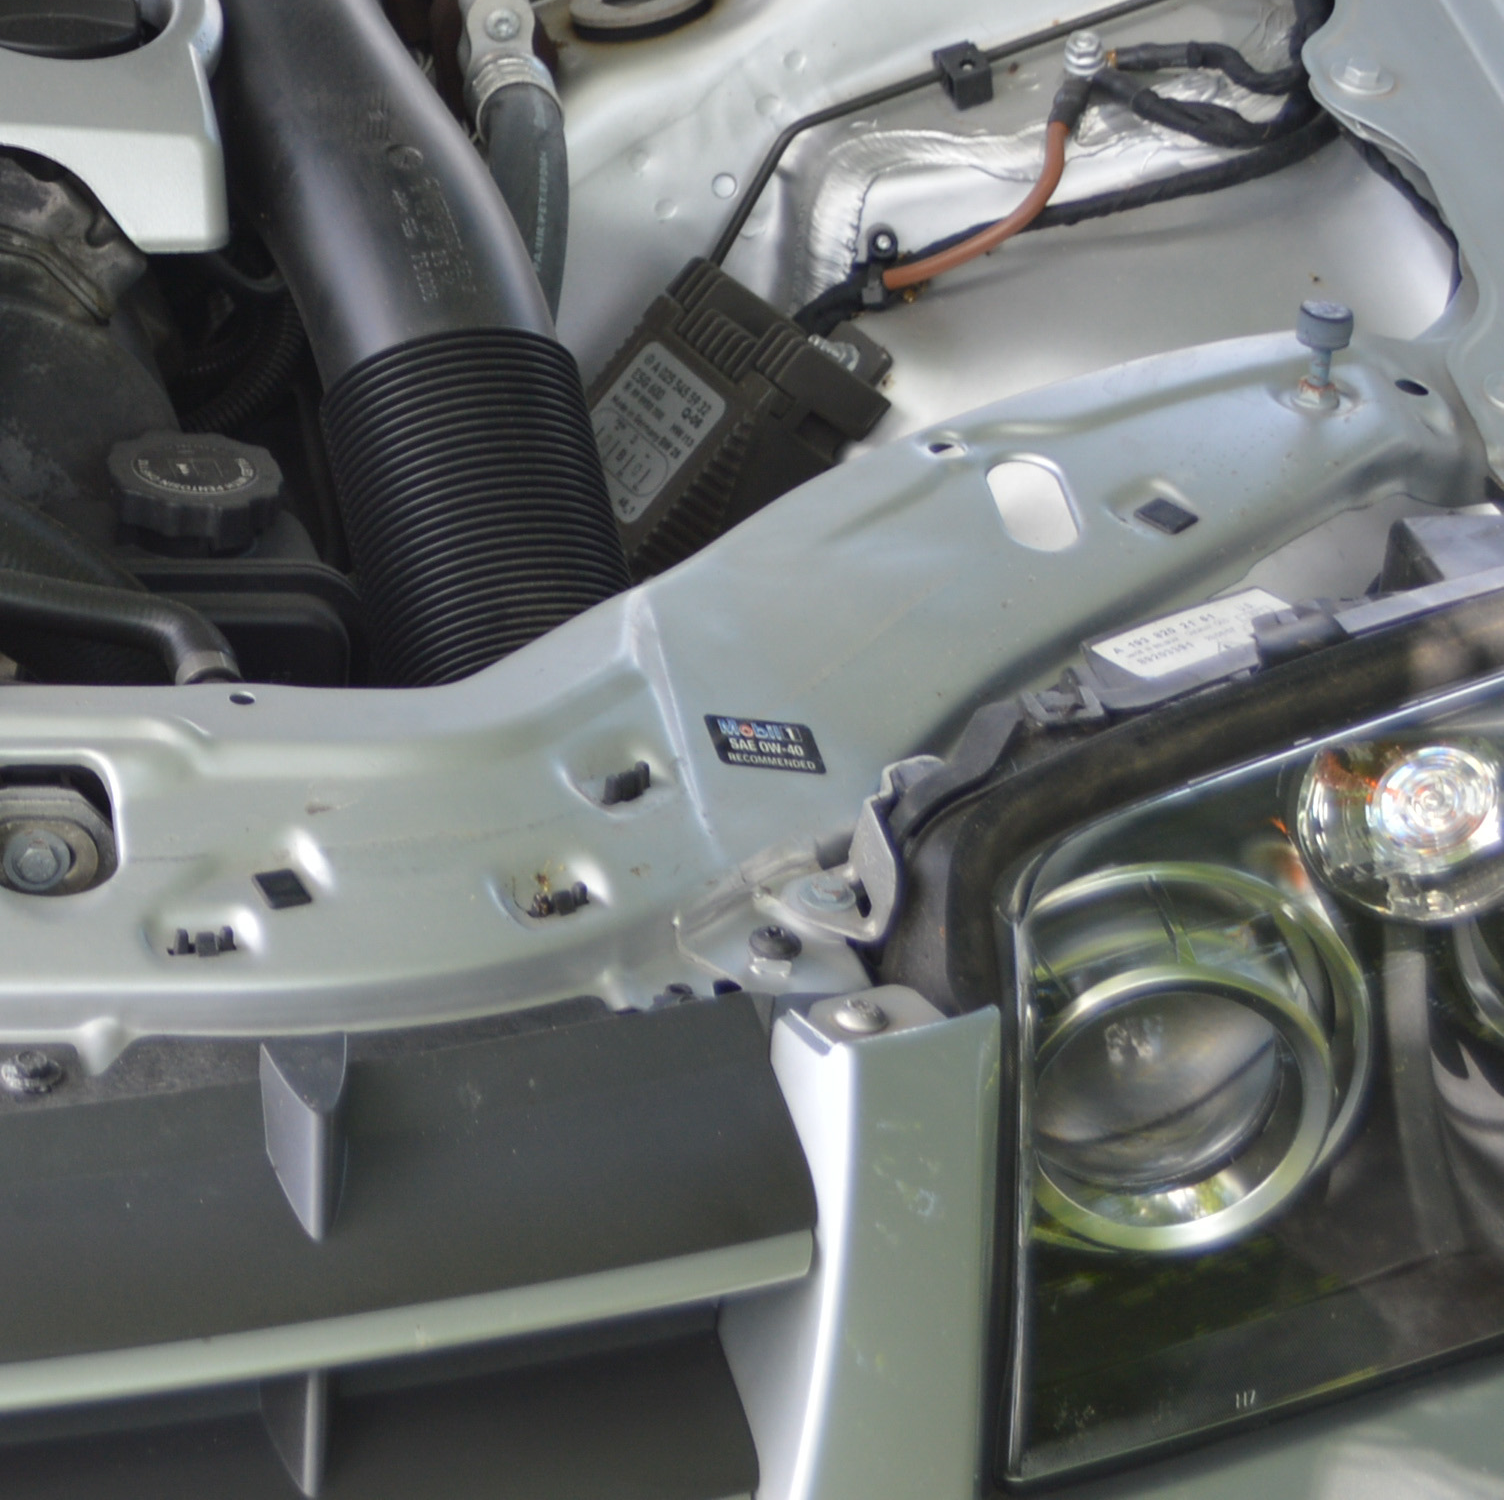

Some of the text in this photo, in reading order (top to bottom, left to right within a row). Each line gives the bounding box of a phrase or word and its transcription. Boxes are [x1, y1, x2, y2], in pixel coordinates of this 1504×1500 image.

[717, 718, 781, 741] Mobil
[729, 738, 804, 756] SAE 0W-40
[727, 753, 815, 769] RECOMMENDED
